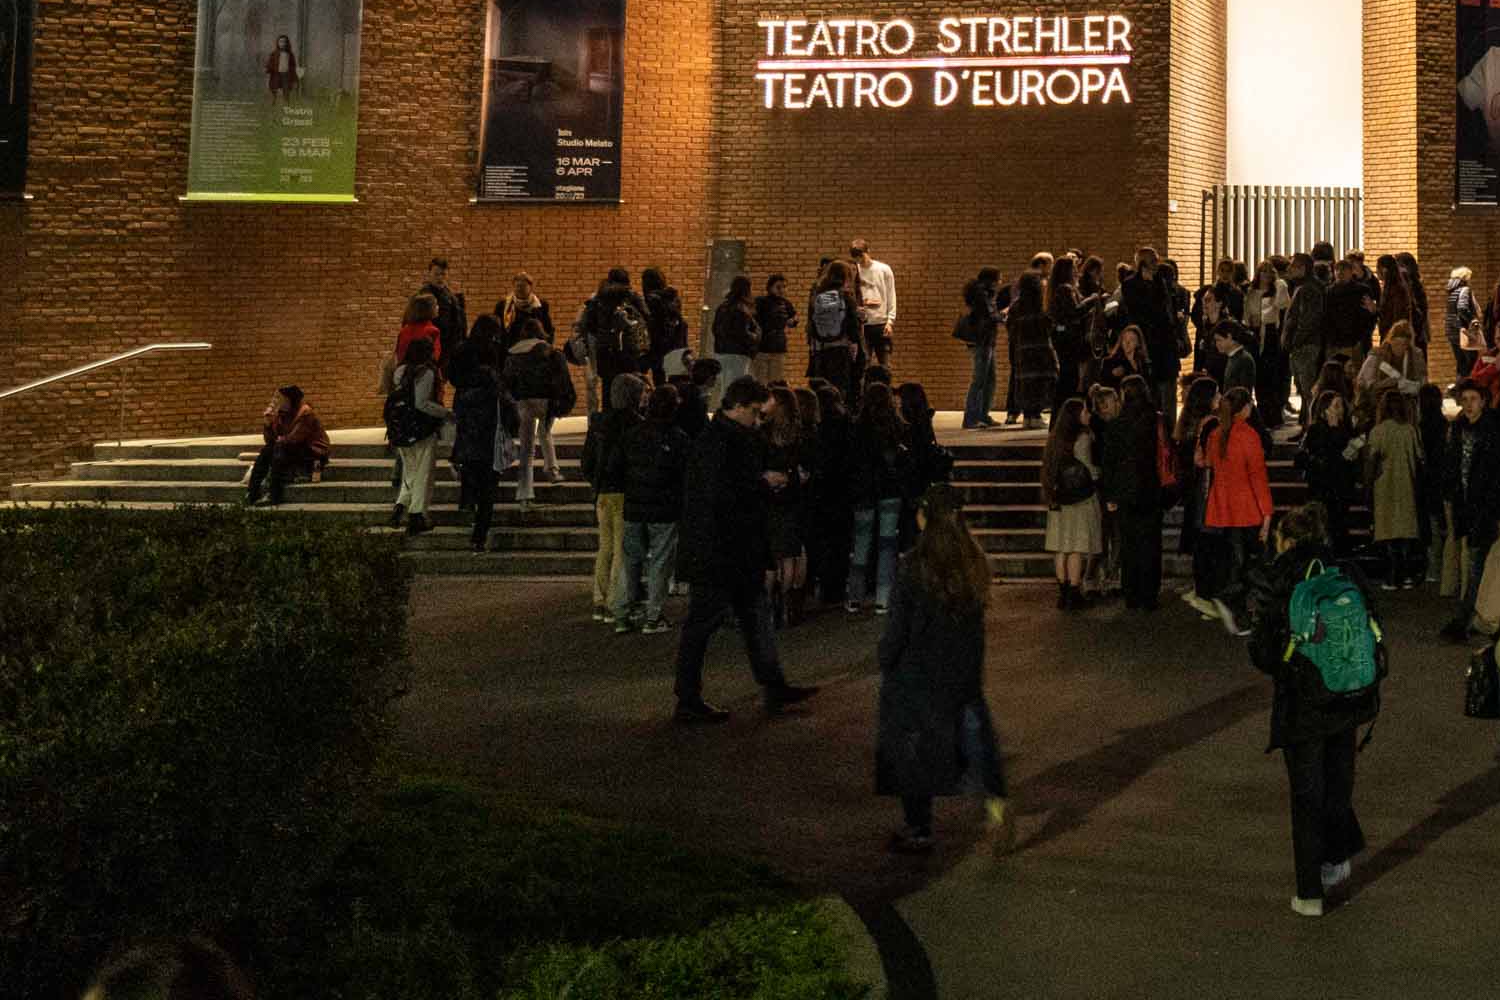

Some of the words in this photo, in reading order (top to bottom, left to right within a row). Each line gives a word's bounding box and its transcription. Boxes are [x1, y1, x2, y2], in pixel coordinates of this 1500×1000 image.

[758, 17, 915, 56] TEATRO
[937, 15, 1132, 54] STREHLER
[756, 71, 913, 109] TEATRO
[934, 68, 1132, 107] D'EUROPA
[557, 138, 585, 147] Studio
[557, 157, 571, 166] 16
[572, 157, 601, 166] MAR
[556, 167, 565, 176] 6
[567, 167, 593, 176] APR
